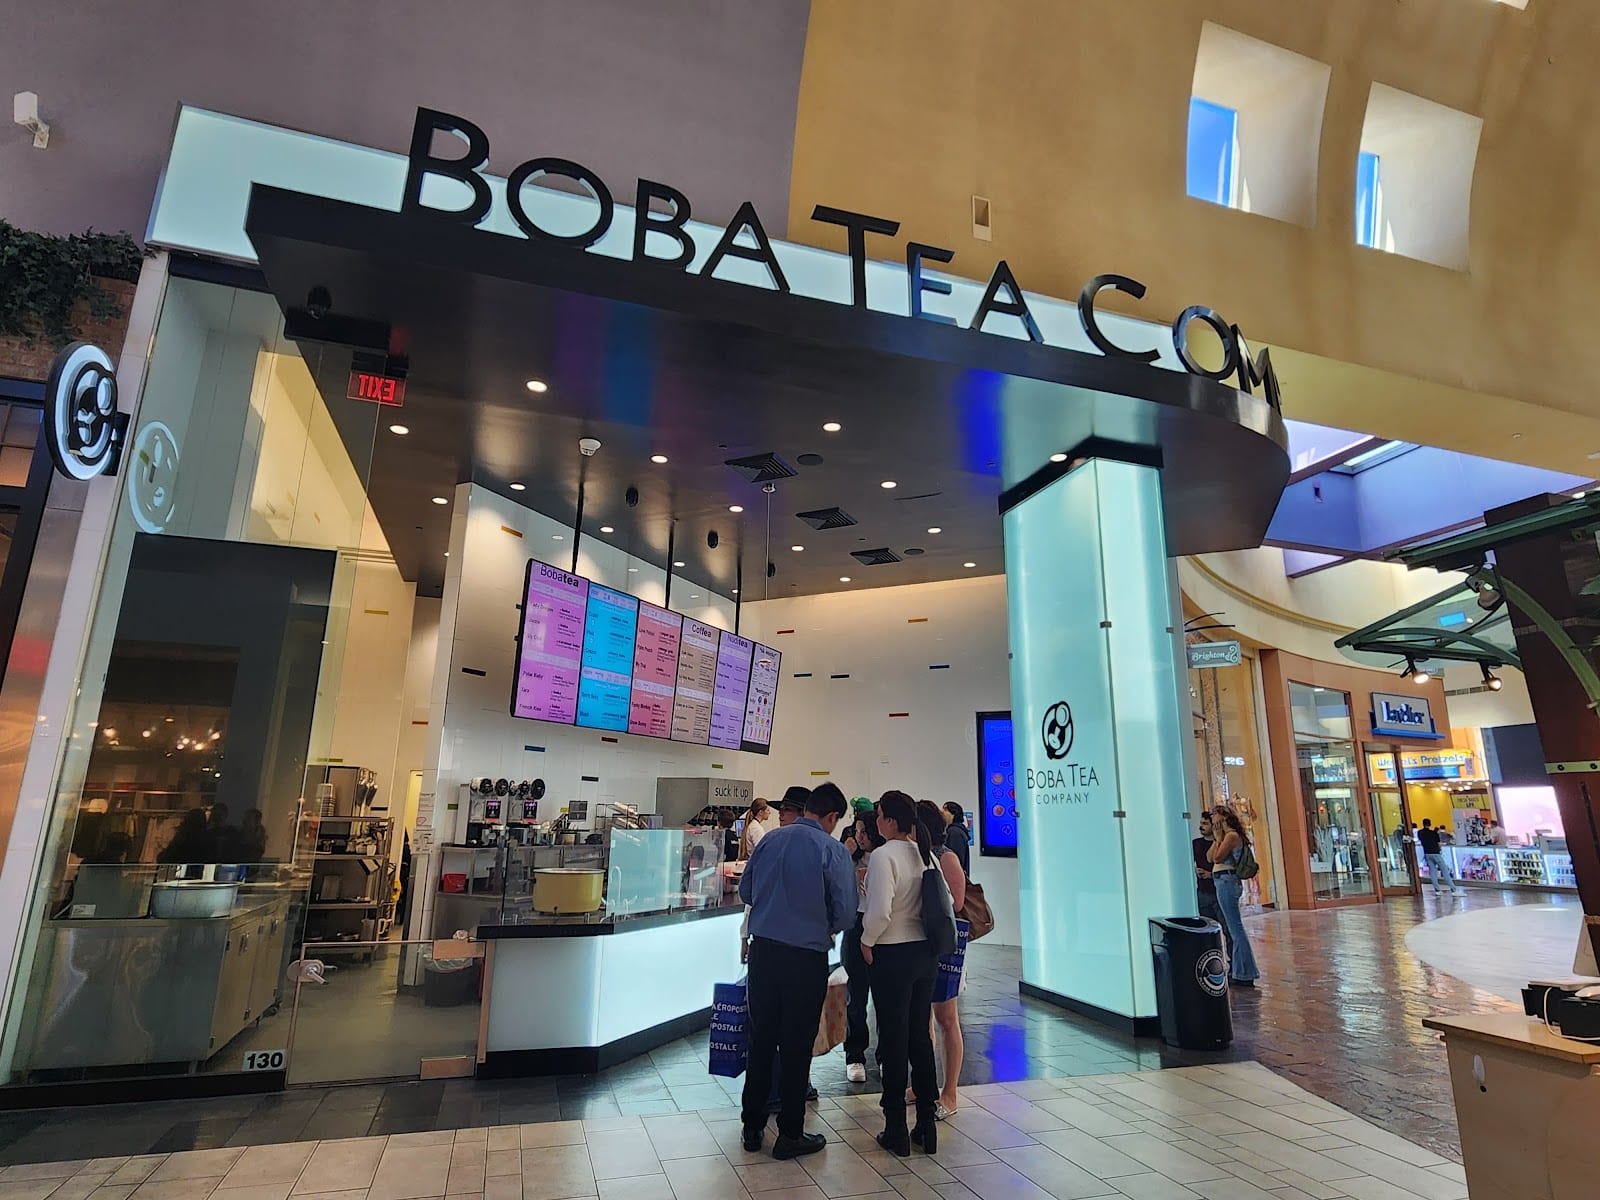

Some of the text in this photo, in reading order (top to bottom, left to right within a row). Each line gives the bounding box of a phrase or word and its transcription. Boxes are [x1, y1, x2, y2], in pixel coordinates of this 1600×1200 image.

[401, 106, 1282, 420] BOBA TEA COM
[540, 564, 579, 587] Bobatea
[692, 624, 712, 638] Coffea
[1191, 650, 1226, 661] Brighton
[1026, 763, 1100, 789] BOBA TEA
[714, 784, 749, 801] suck it up
[1035, 792, 1090, 805] COMPANY
[247, 1052, 284, 1069] 130
